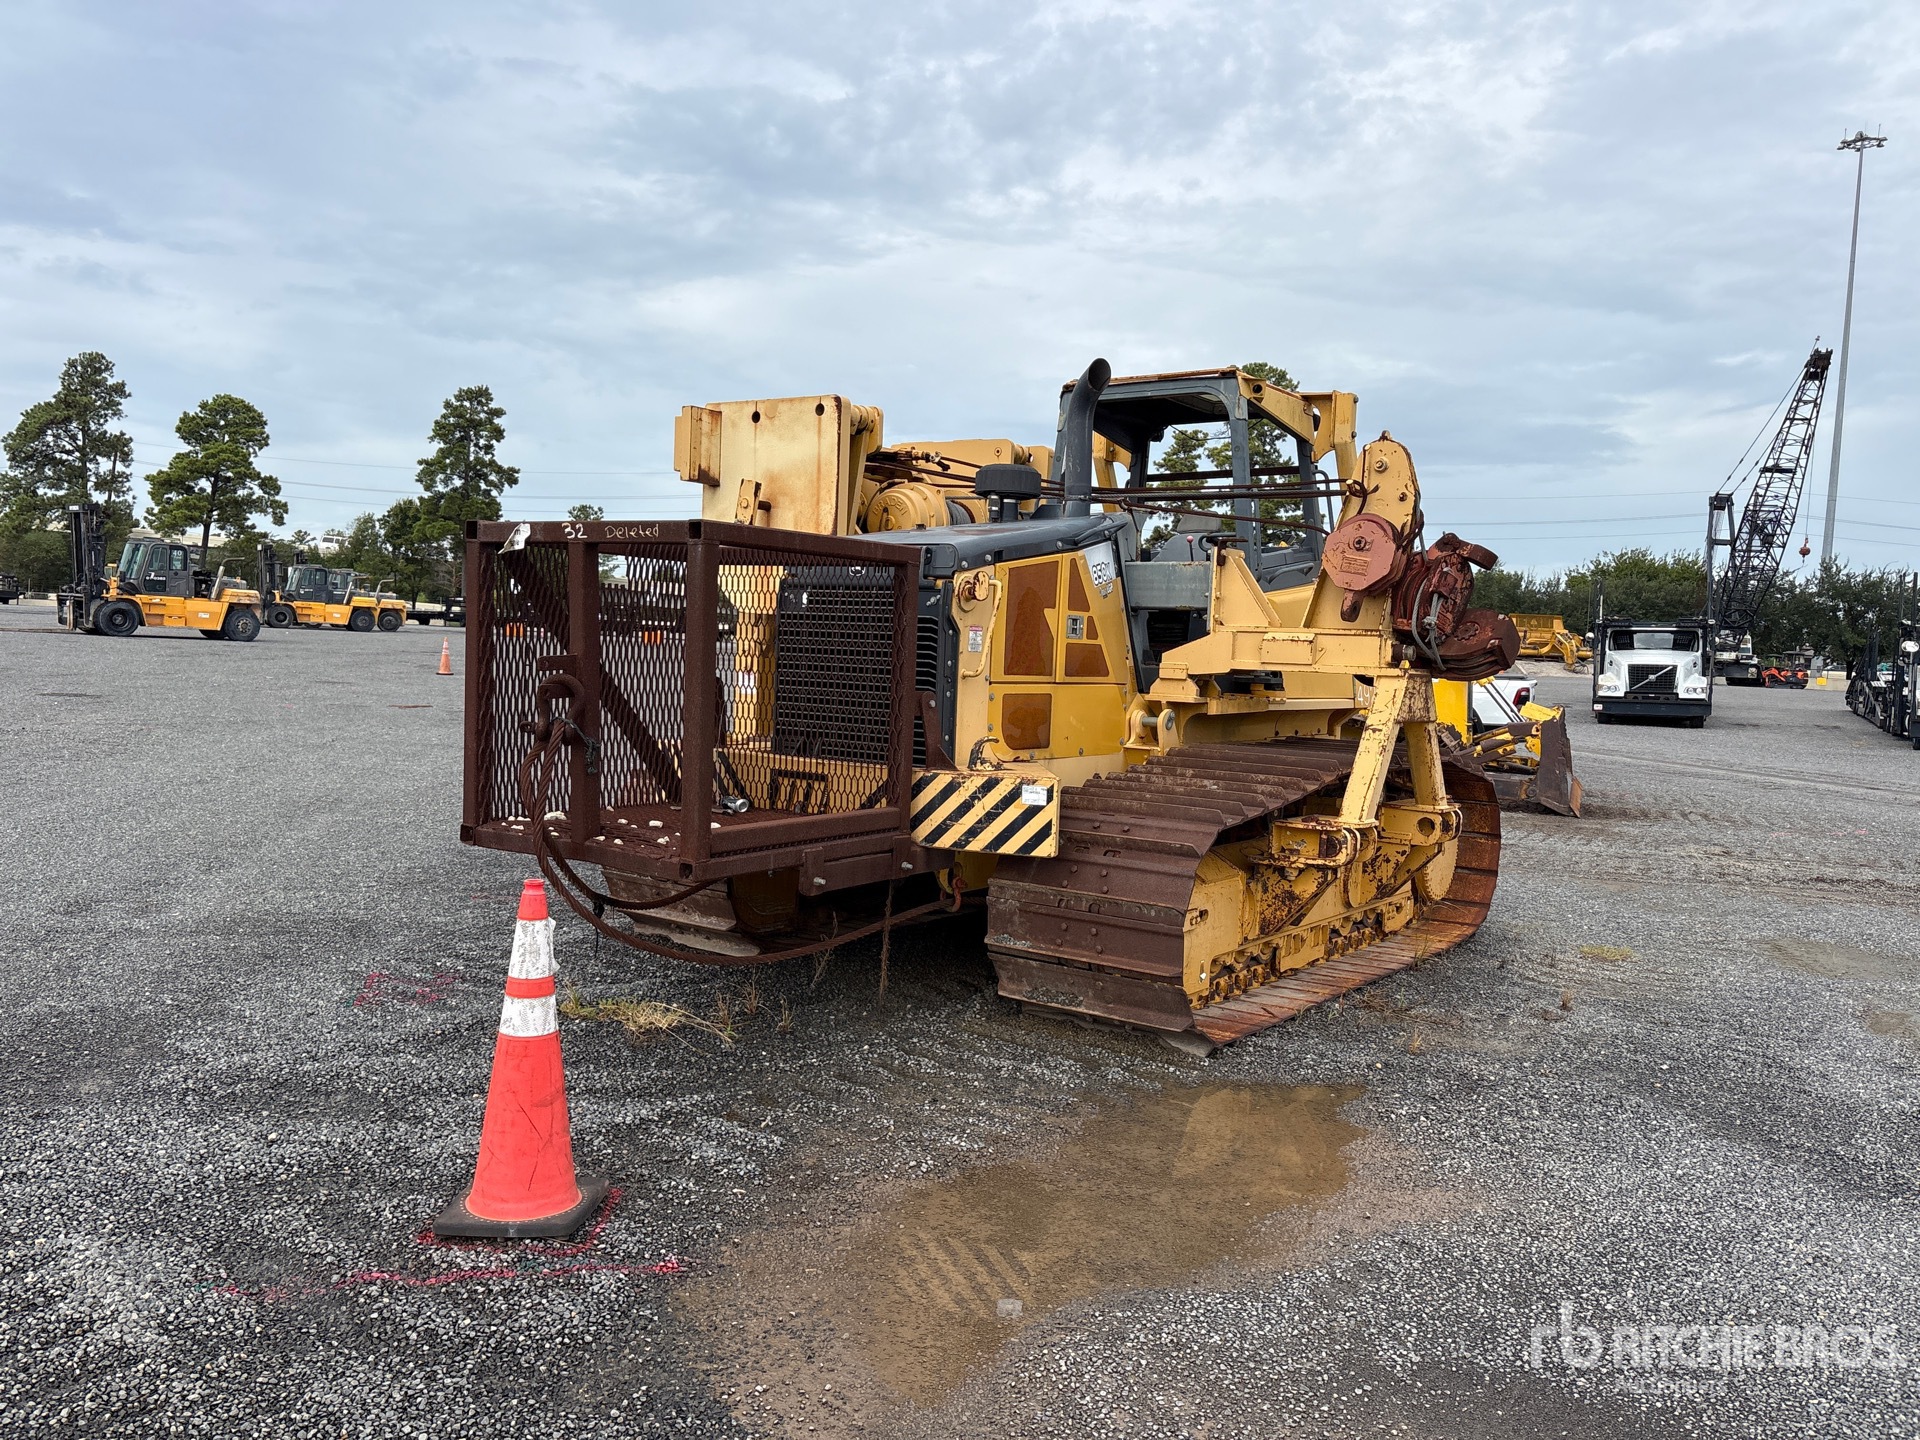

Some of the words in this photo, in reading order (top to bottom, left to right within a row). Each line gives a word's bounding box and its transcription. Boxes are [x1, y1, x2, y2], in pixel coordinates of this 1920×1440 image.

[872, 496, 908, 516] BRADEN
[562, 522, 588, 539] 32
[604, 524, 659, 539] Deleted
